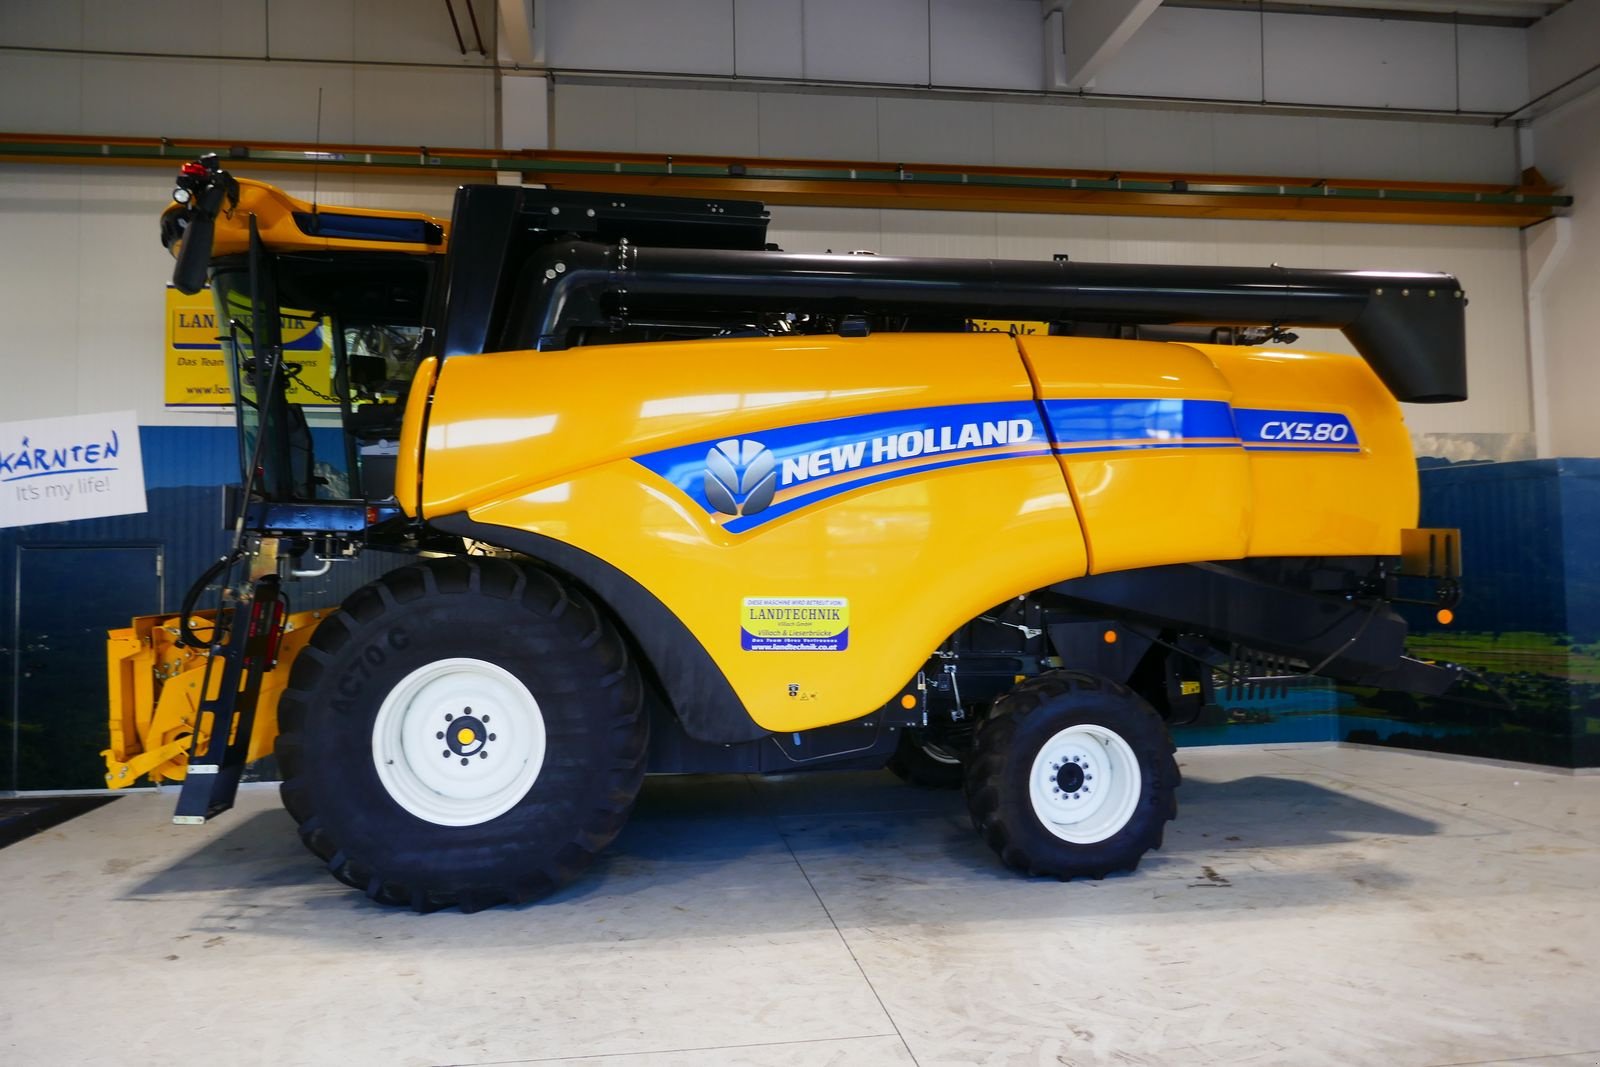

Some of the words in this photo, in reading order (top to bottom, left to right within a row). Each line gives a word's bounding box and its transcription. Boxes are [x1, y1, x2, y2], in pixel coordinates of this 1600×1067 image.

[177, 357, 198, 367] Das
[1260, 421, 1349, 442] CX5.80
[782, 441, 867, 486] NEW
[872, 419, 1034, 464] HOLLAND
[16, 484, 40, 501] It's
[45, 483, 74, 501] my
[78, 476, 111, 495] life!
[749, 608, 841, 621] LANDTECHNIK
[758, 629, 781, 637] Villach
[782, 629, 788, 637] &
